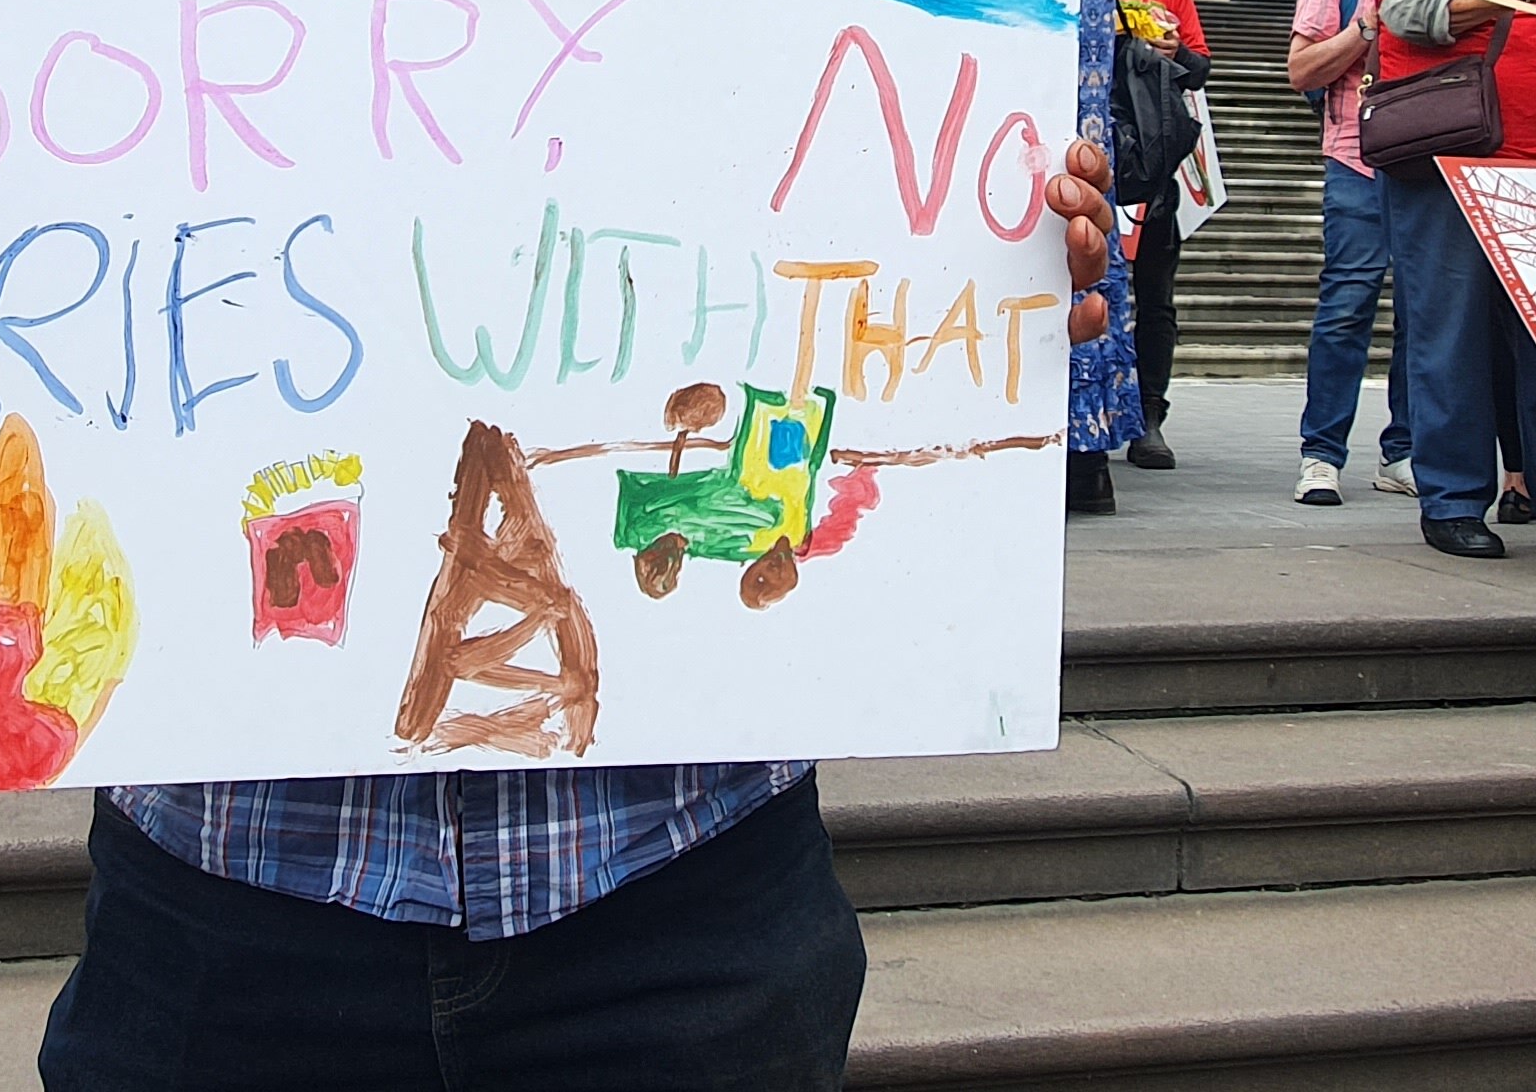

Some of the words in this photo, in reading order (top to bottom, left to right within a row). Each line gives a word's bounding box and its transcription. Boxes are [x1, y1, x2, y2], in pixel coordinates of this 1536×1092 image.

[412, 196, 767, 392] WITH
[772, 259, 1062, 412] THAT
[1452, 175, 1476, 207] JOIN
[1471, 210, 1491, 237] THE
[1487, 238, 1517, 285] FIGHT.
